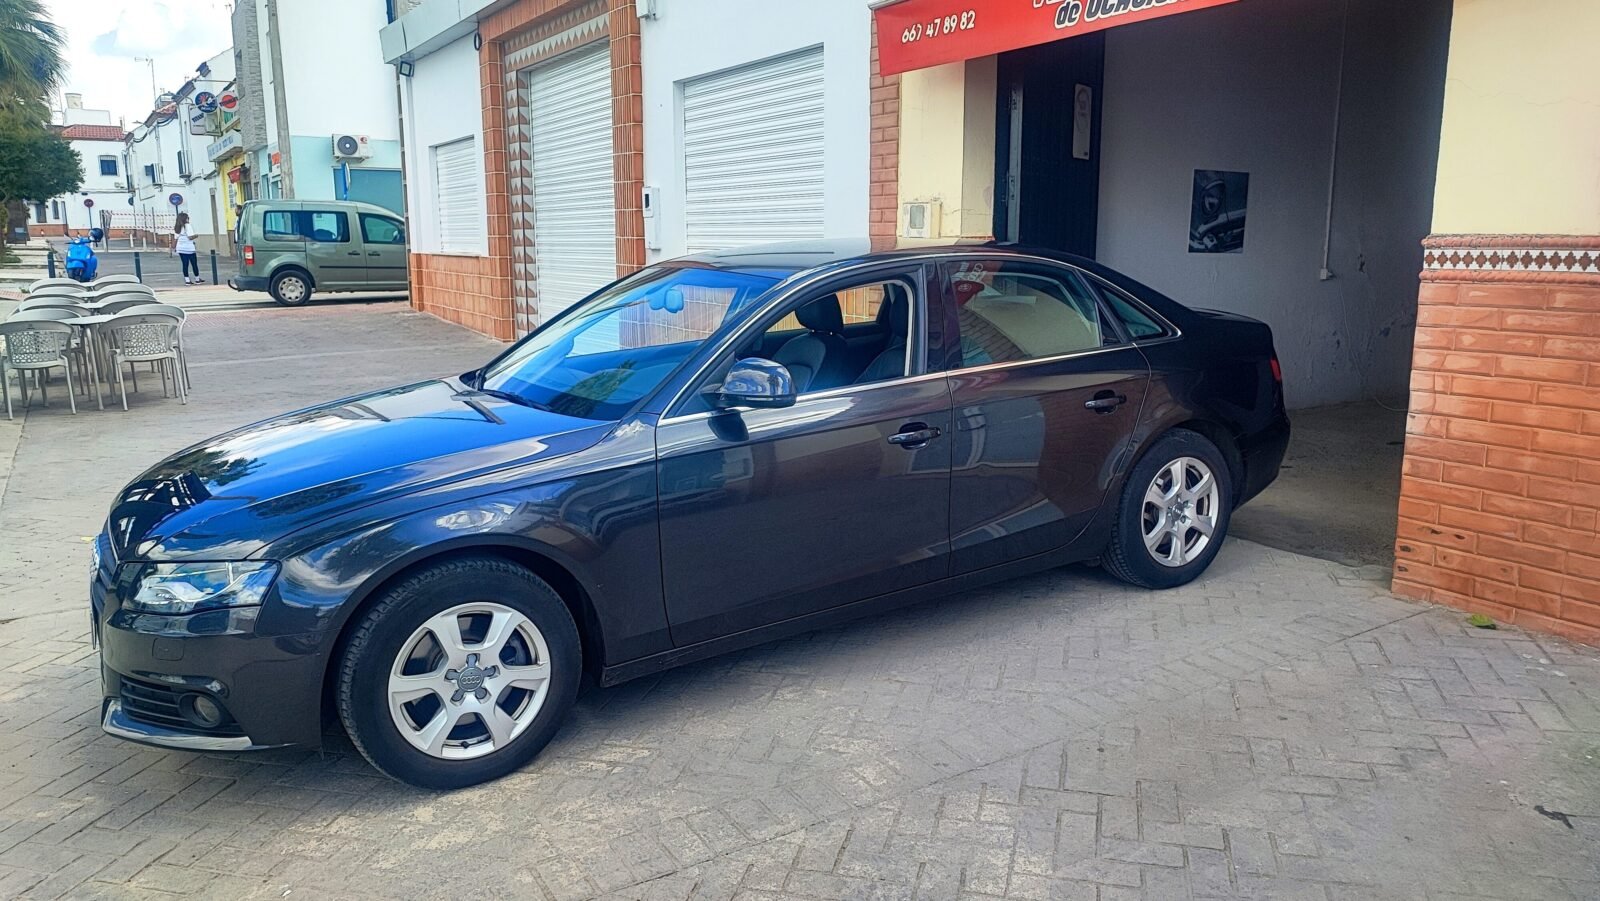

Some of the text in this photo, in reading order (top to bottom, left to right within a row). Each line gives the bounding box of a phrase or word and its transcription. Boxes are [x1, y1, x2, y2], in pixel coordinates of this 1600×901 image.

[926, 18, 941, 37] 47
[943, 14, 958, 34] 89
[960, 9, 976, 30] 82
[1055, 1, 1081, 28] de
